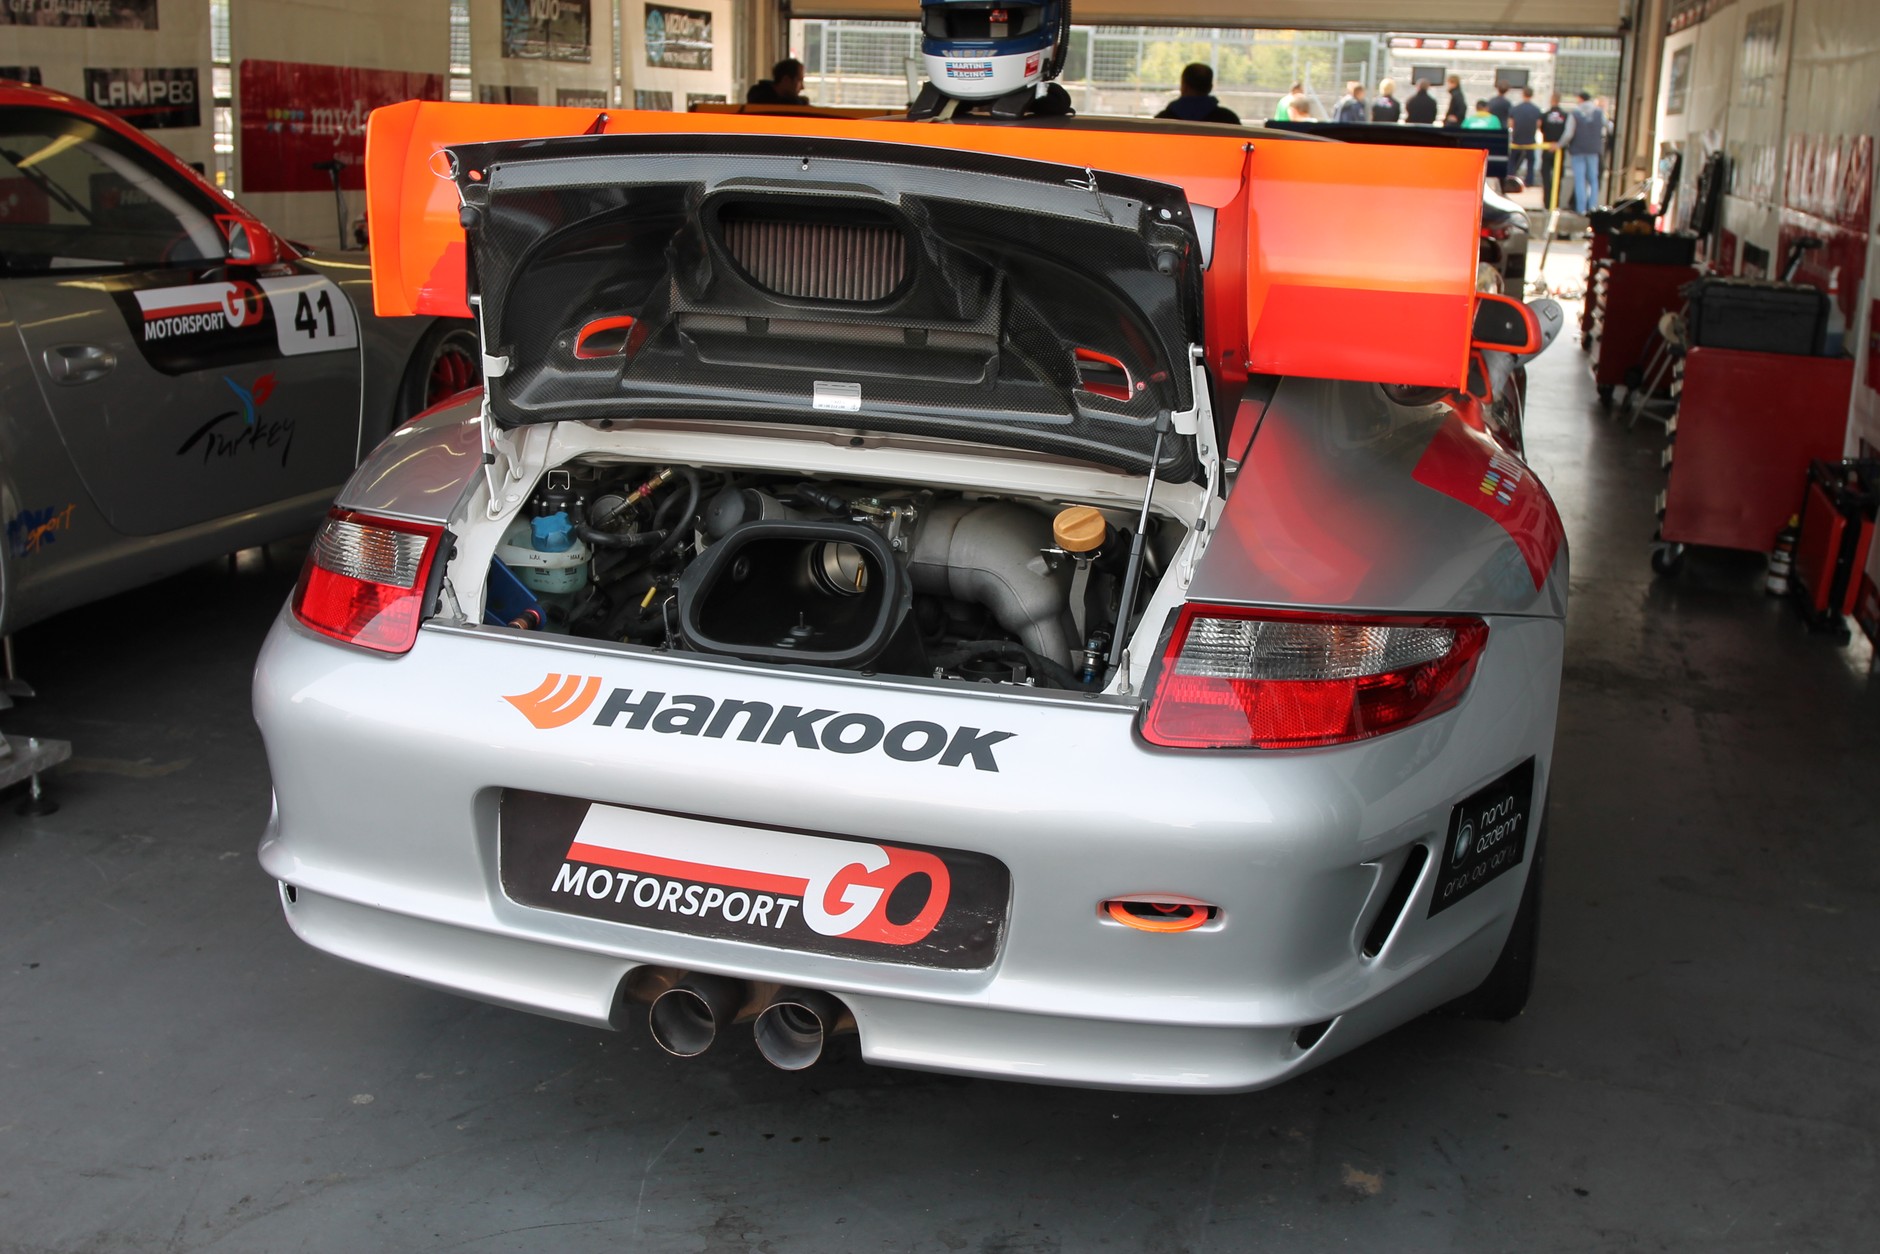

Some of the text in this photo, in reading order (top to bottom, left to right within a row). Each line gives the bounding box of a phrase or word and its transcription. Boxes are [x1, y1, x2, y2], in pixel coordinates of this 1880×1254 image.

[953, 70, 986, 78] RACING
[144, 280, 264, 342] MOTORSPORT GO
[294, 289, 336, 339] 41
[176, 410, 296, 468] Turkey
[551, 842, 951, 946] MOTORSPORT GO
